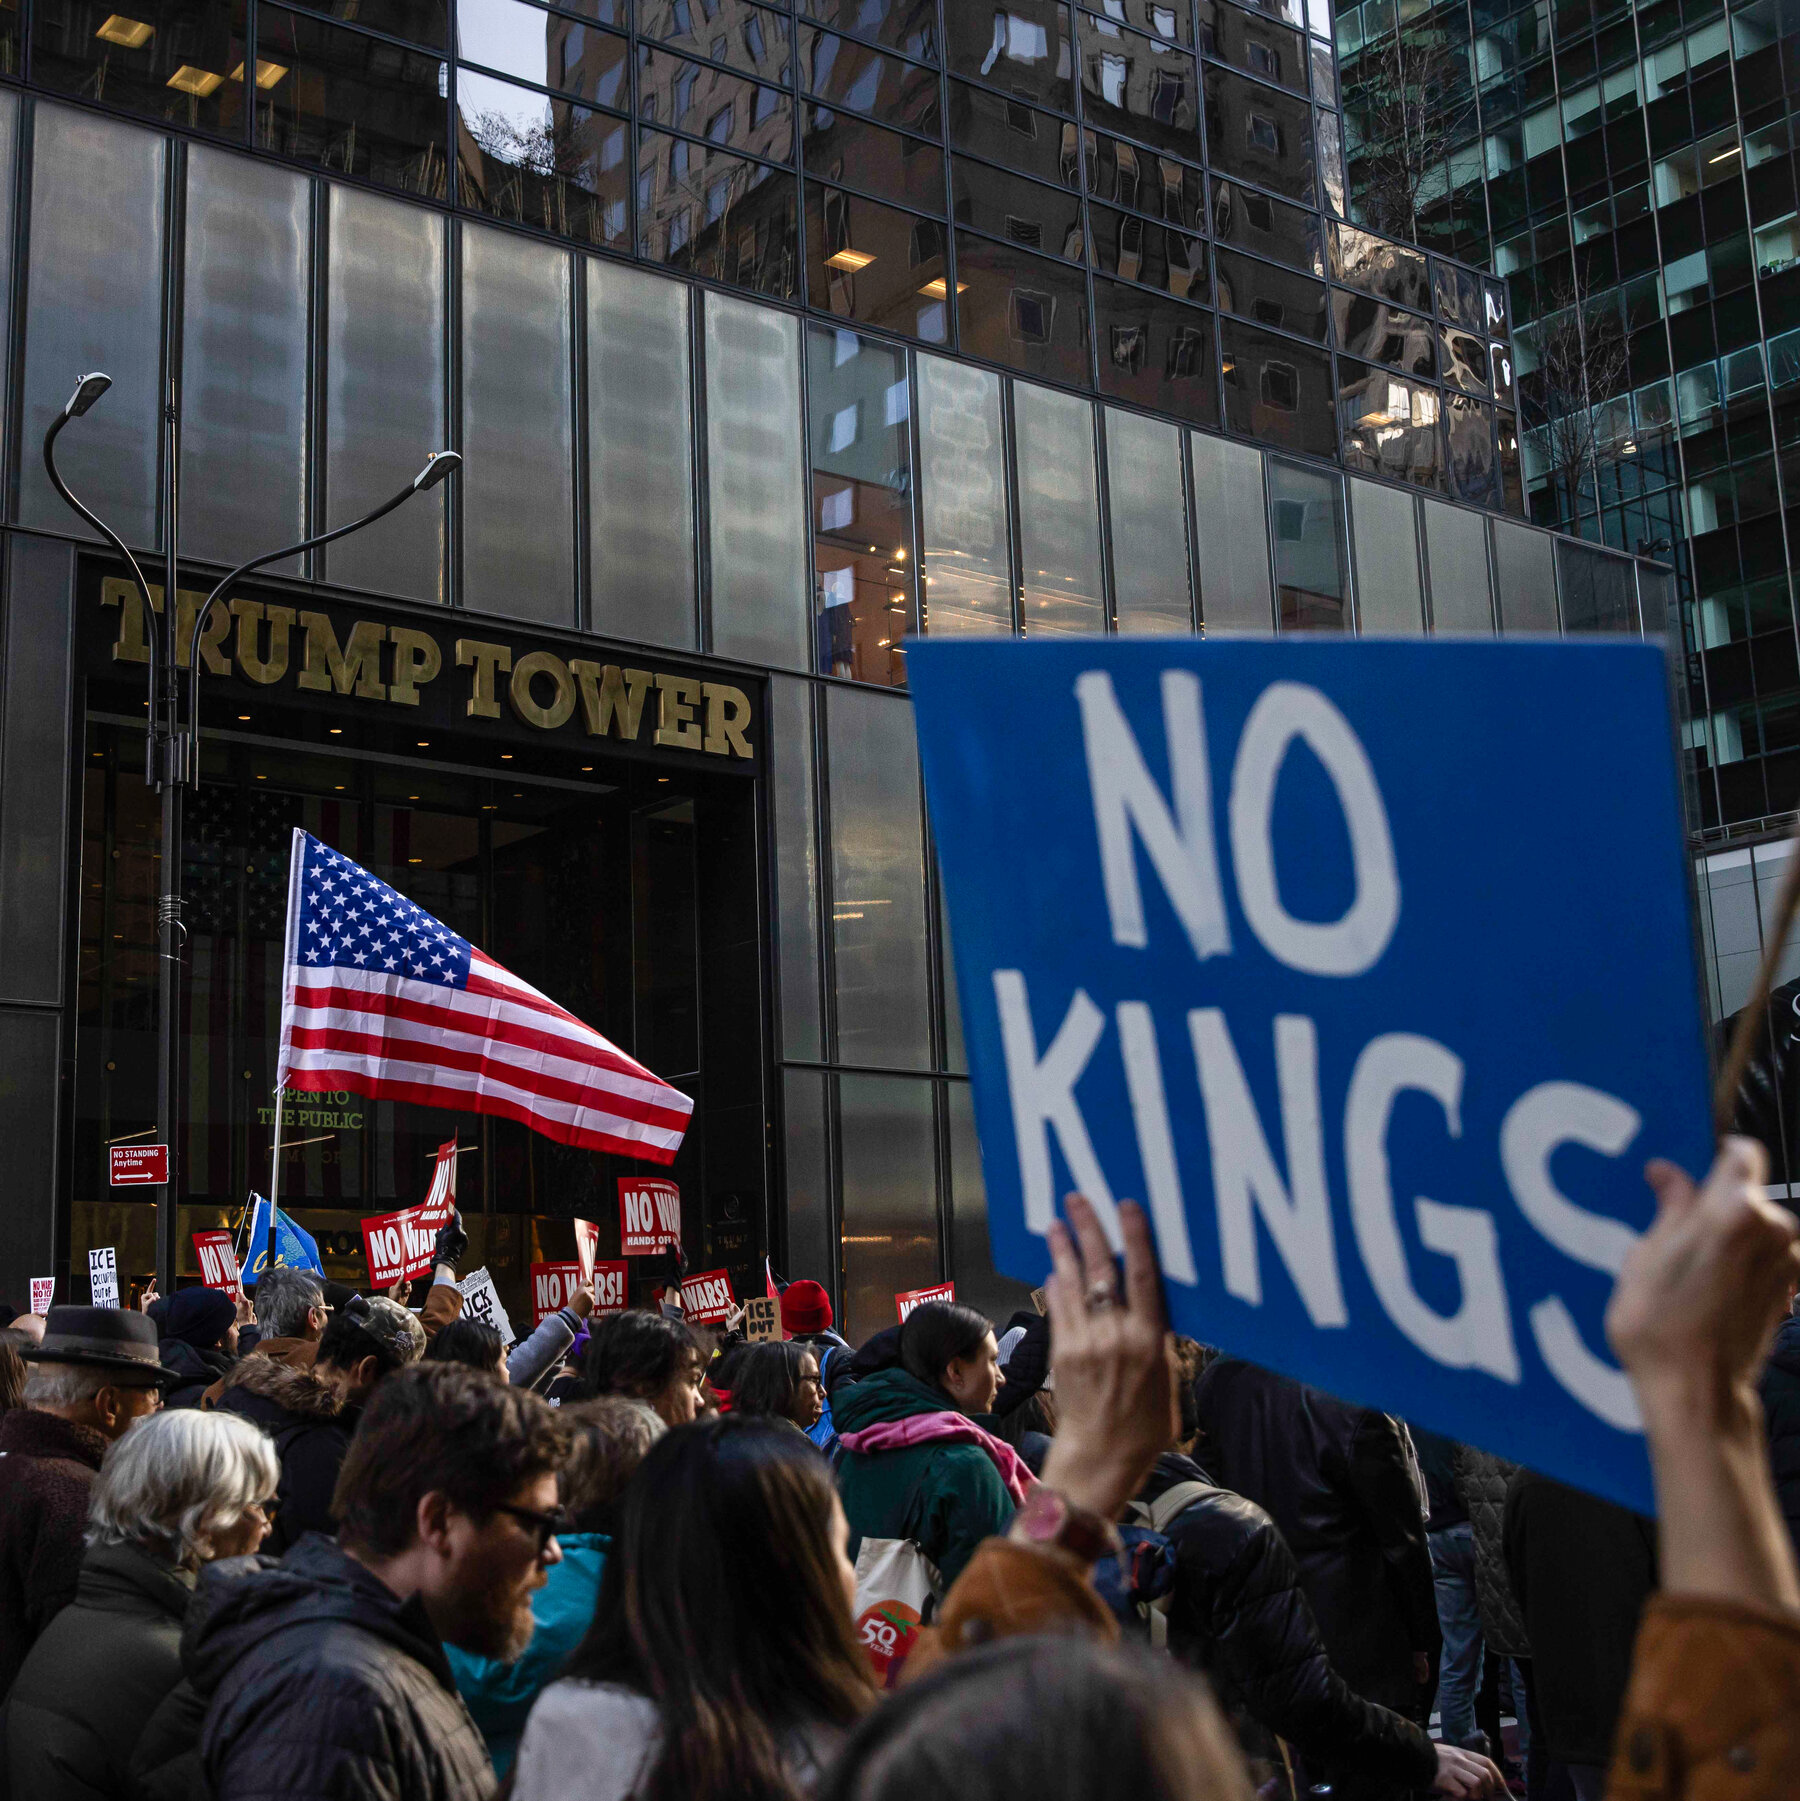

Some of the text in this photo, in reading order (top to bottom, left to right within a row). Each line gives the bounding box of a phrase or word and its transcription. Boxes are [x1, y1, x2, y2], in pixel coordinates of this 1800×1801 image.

[101, 575, 754, 760] TRUMP TOWER
[1074, 668, 1401, 978] NO
[298, 1109, 363, 1129] PUBLIC
[113, 1159, 143, 1168] Anytime
[125, 1149, 159, 1158] STANDING
[426, 1158, 450, 1206] NO
[991, 967, 1643, 1434] KINGS
[624, 1191, 654, 1233] NO
[369, 1226, 402, 1269] NO
[627, 1235, 672, 1246] HANDS OFF
[90, 1249, 115, 1270] ICE
[198, 1244, 222, 1285] NO
[375, 1267, 405, 1280] HANDS
[406, 1261, 417, 1273] OFF
[33, 1280, 53, 1290] NO WARS
[33, 1289, 52, 1298] NO ICE
[94, 1288, 104, 1298] OUT
[536, 1273, 561, 1309] NO
[564, 1271, 623, 1306] WRS!
[680, 1277, 730, 1313] WARS!
[462, 1286, 493, 1320] UCK
[749, 1301, 775, 1319] ICE
[749, 1320, 775, 1334] OUT
[869, 1643, 895, 1657] YEARS
